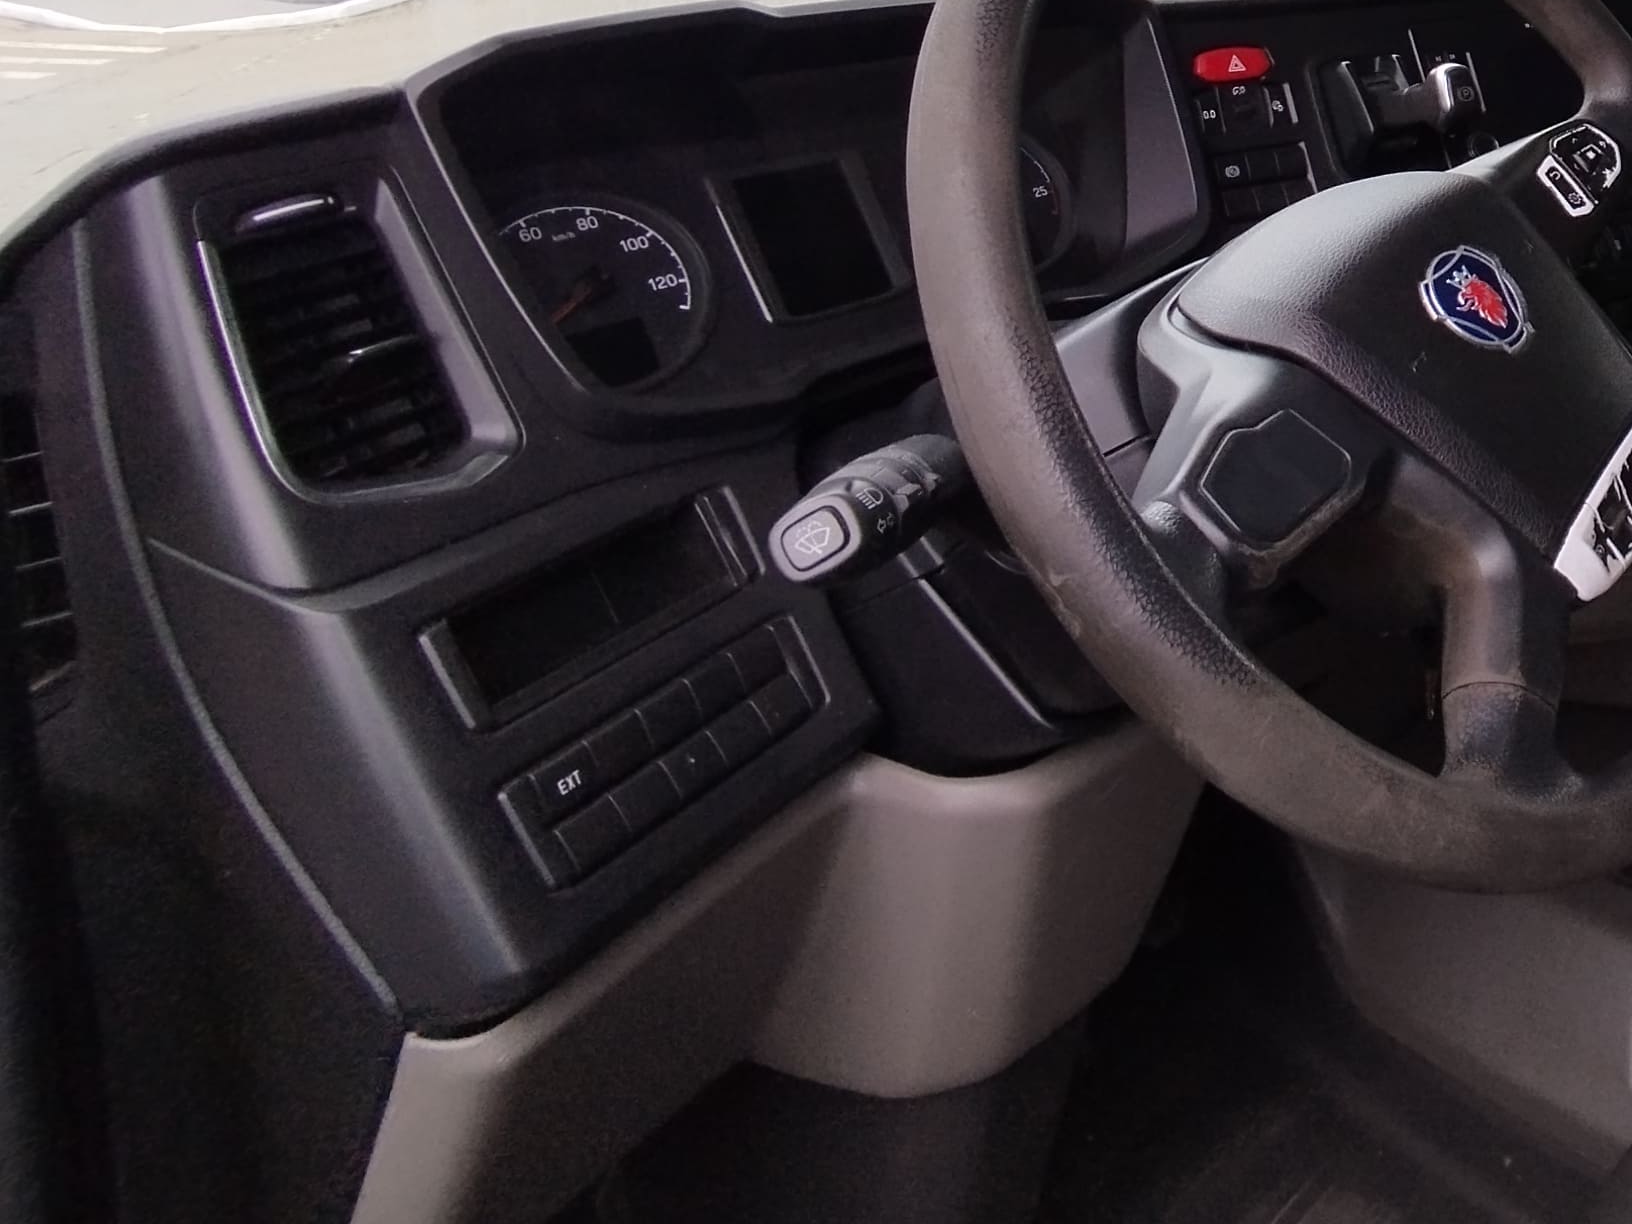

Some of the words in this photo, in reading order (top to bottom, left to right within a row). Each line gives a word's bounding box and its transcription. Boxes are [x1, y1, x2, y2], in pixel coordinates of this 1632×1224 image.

[1033, 186, 1048, 198] 25
[576, 216, 599, 231] 80
[519, 227, 542, 242] 60
[619, 236, 649, 252] 100
[648, 274, 678, 291] 120
[557, 769, 581, 795] EXT
